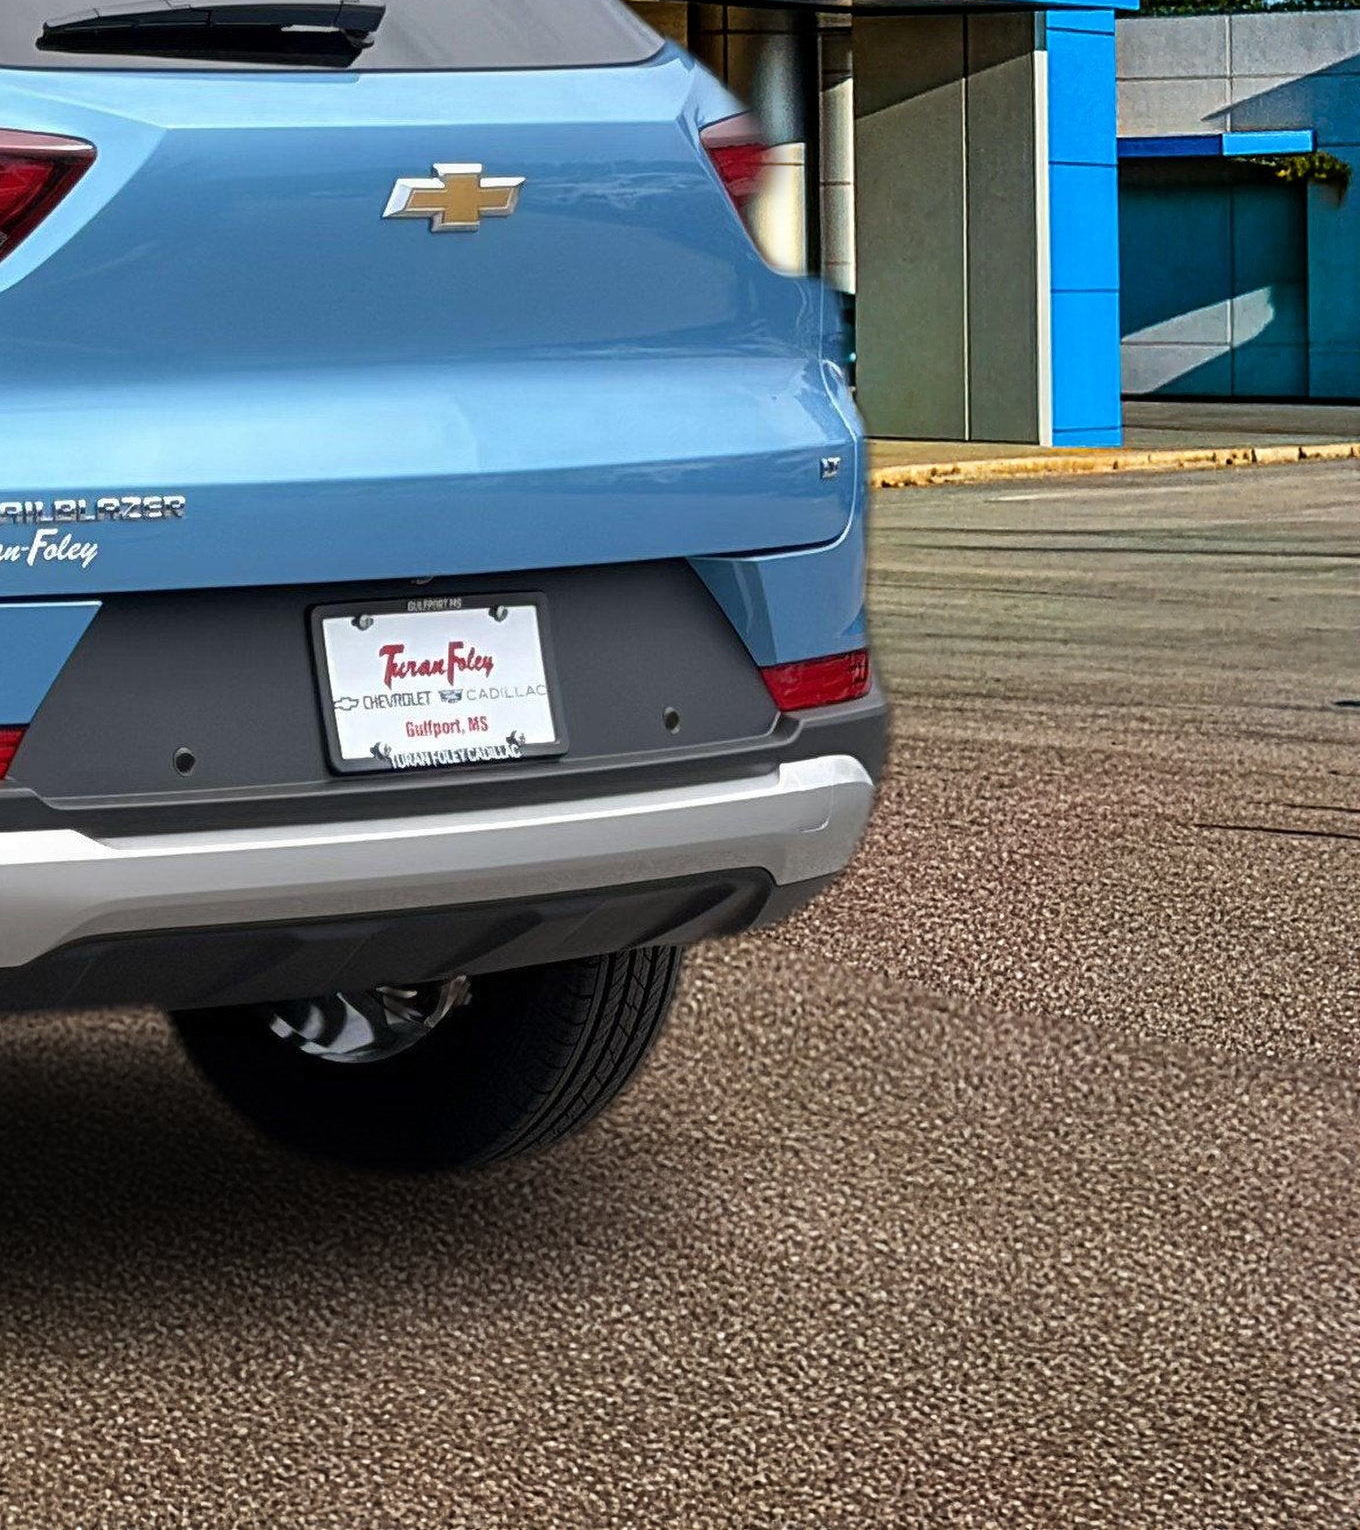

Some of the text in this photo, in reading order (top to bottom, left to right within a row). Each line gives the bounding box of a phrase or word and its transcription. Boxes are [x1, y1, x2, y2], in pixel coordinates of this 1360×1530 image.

[363, 683, 547, 710] CHEVROLET CADILLAC
[468, 716, 489, 732] MS
